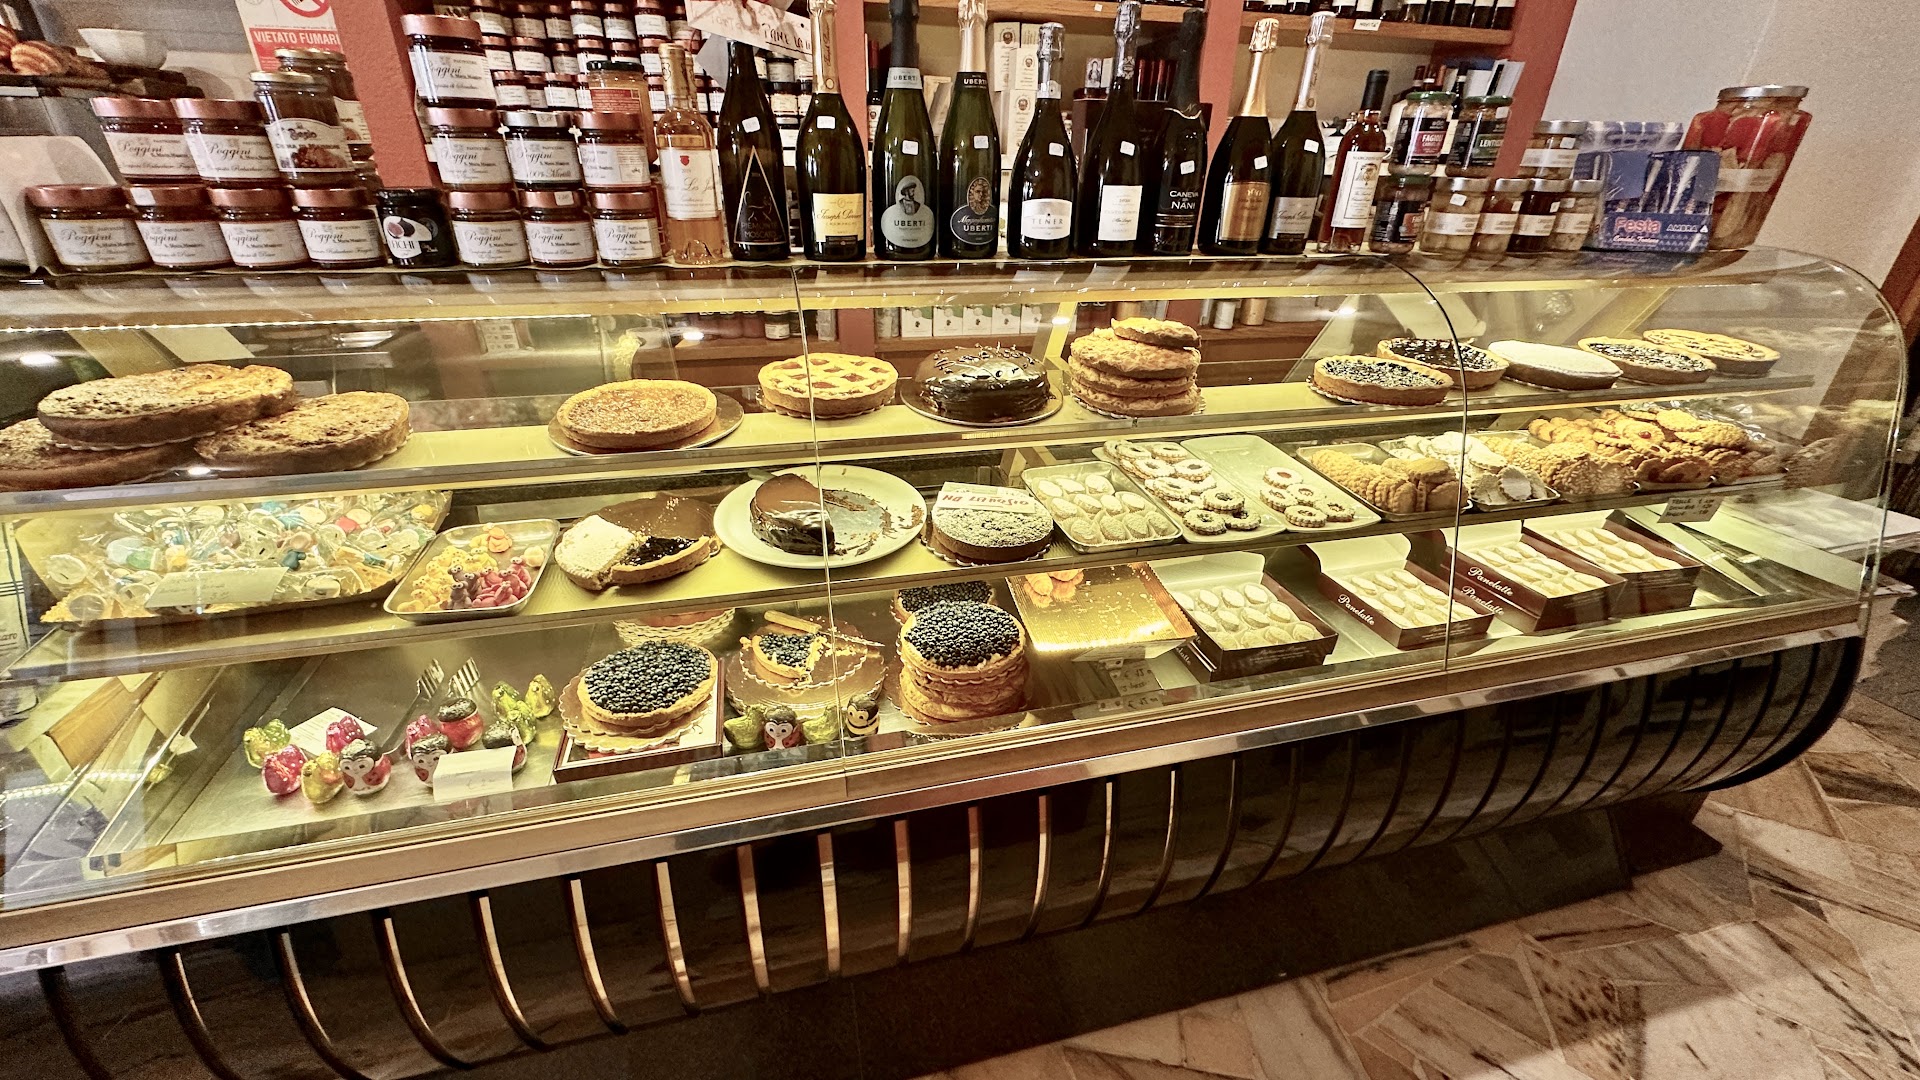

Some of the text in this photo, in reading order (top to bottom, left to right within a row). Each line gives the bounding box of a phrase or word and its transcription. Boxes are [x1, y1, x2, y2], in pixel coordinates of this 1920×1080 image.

[254, 30, 298, 44] VIETATO
[117, 141, 162, 157] Poggini
[206, 142, 251, 160] Poggini
[1171, 201, 1196, 210] NANI
[1614, 216, 1698, 234] Festa AMBRA
[61, 228, 112, 246] Poggini
[306, 228, 343, 244] Poggini
[464, 230, 502, 245] Poggini
[531, 229, 563, 243] Poggini
[603, 228, 637, 243] Poggini
[1468, 566, 1514, 597] Panelatte
[1461, 585, 1505, 616] Panelatte
[1338, 593, 1375, 626] Panelatte
